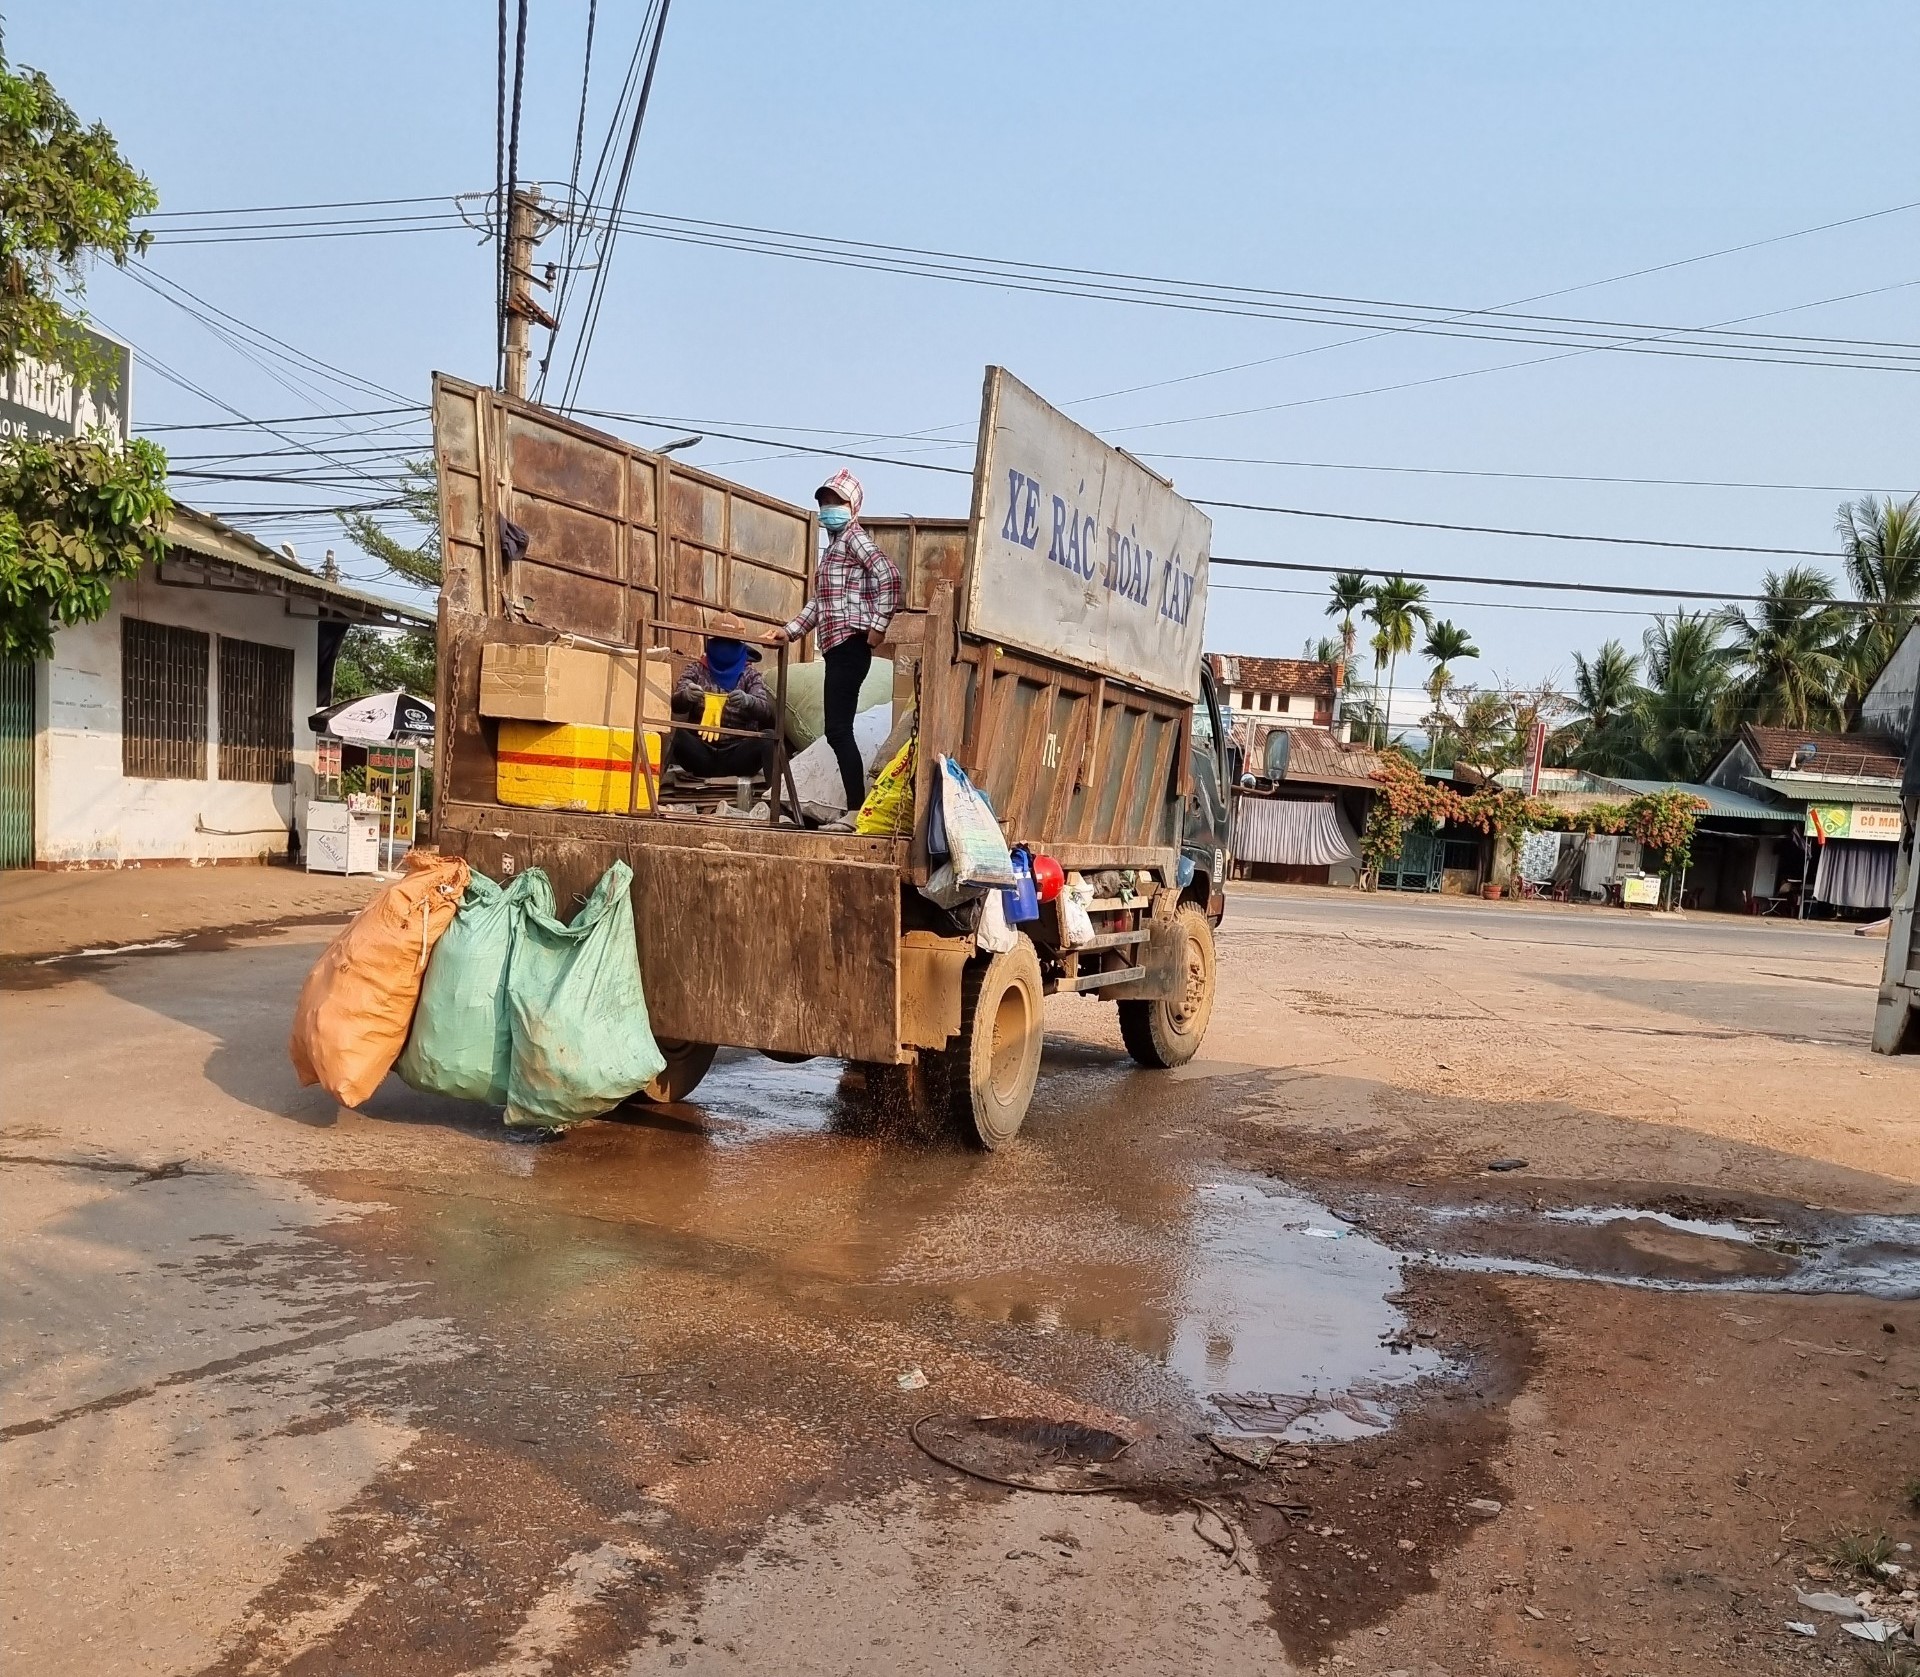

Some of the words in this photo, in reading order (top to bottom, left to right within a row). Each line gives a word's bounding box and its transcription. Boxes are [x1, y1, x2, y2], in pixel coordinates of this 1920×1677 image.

[1002, 468, 1041, 550] XE
[1048, 478, 1097, 581] RÁC
[1102, 523, 1154, 607] HOÀI
[1160, 552, 1195, 627] TÂN
[370, 774, 389, 793] BÚN
[1861, 814, 1875, 826] CÔ
[1879, 817, 1899, 828] MAI
